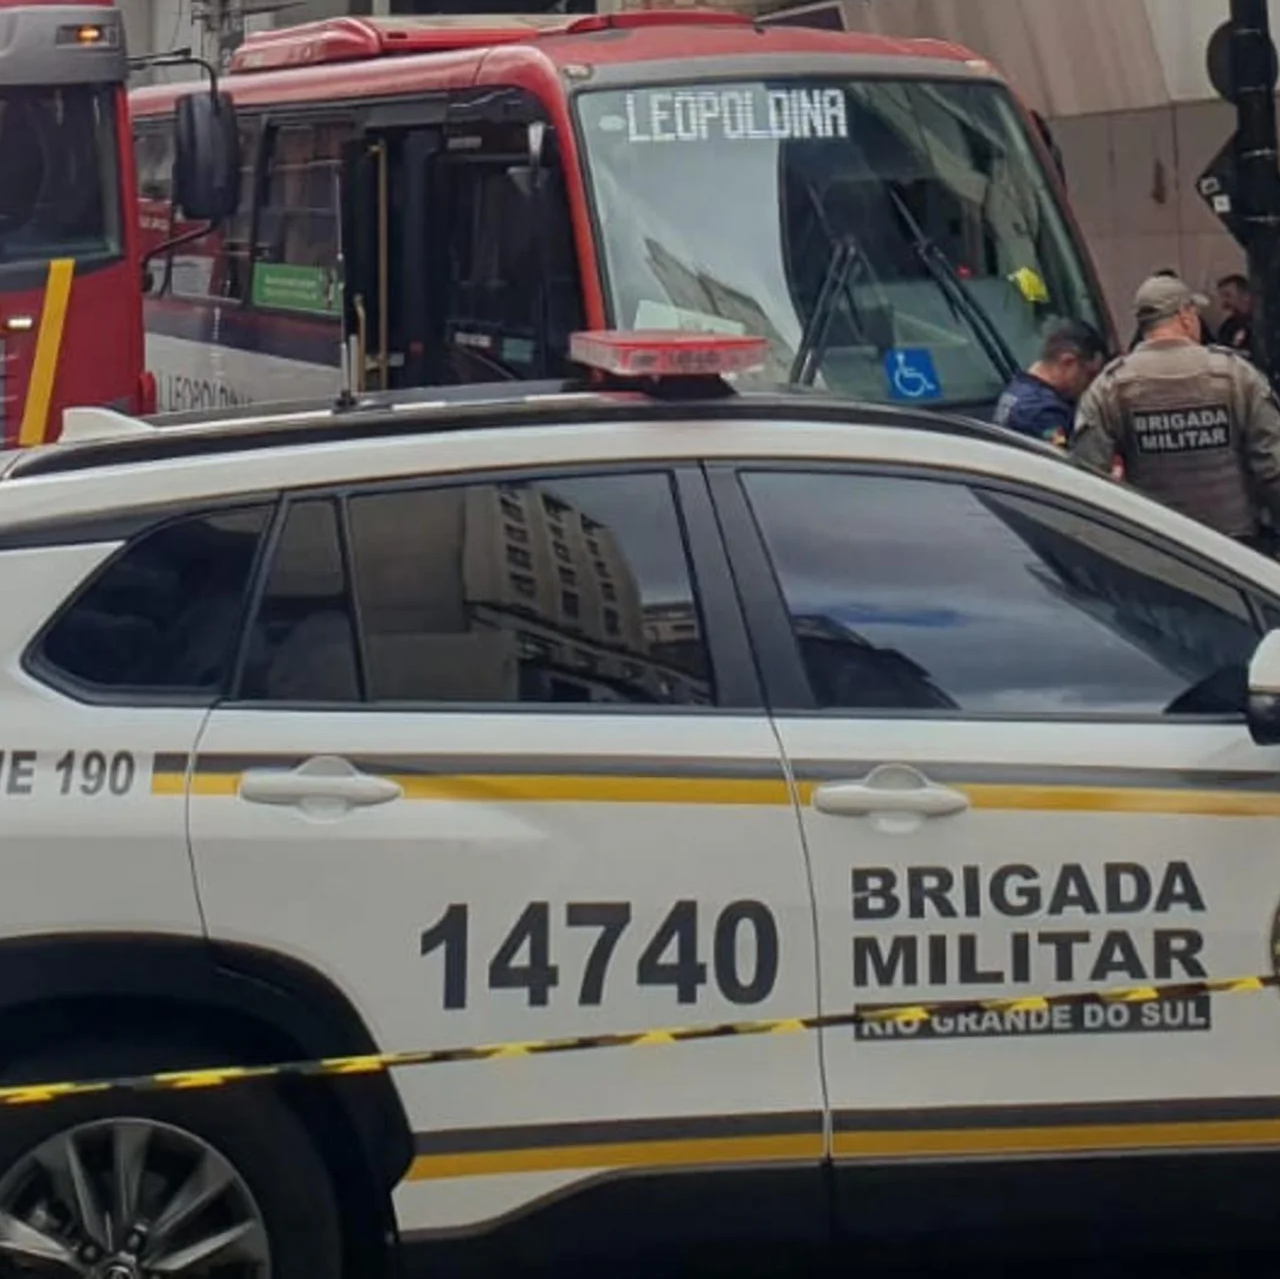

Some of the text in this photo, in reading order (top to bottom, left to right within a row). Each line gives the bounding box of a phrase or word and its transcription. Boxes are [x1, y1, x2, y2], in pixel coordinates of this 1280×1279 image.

[625, 87, 848, 142] LEOPOLDINA
[1134, 410, 1228, 432] BRIGADA
[1141, 428, 1227, 450] MILITAR
[55, 749, 136, 796] 190
[852, 861, 1206, 919] BRIGADA
[420, 900, 779, 1010] 14740
[853, 928, 1208, 987] MILITAR
[931, 1002, 1073, 1033] GRANDE
[1083, 1001, 1130, 1029] DO
[1141, 999, 1206, 1027] SUL
